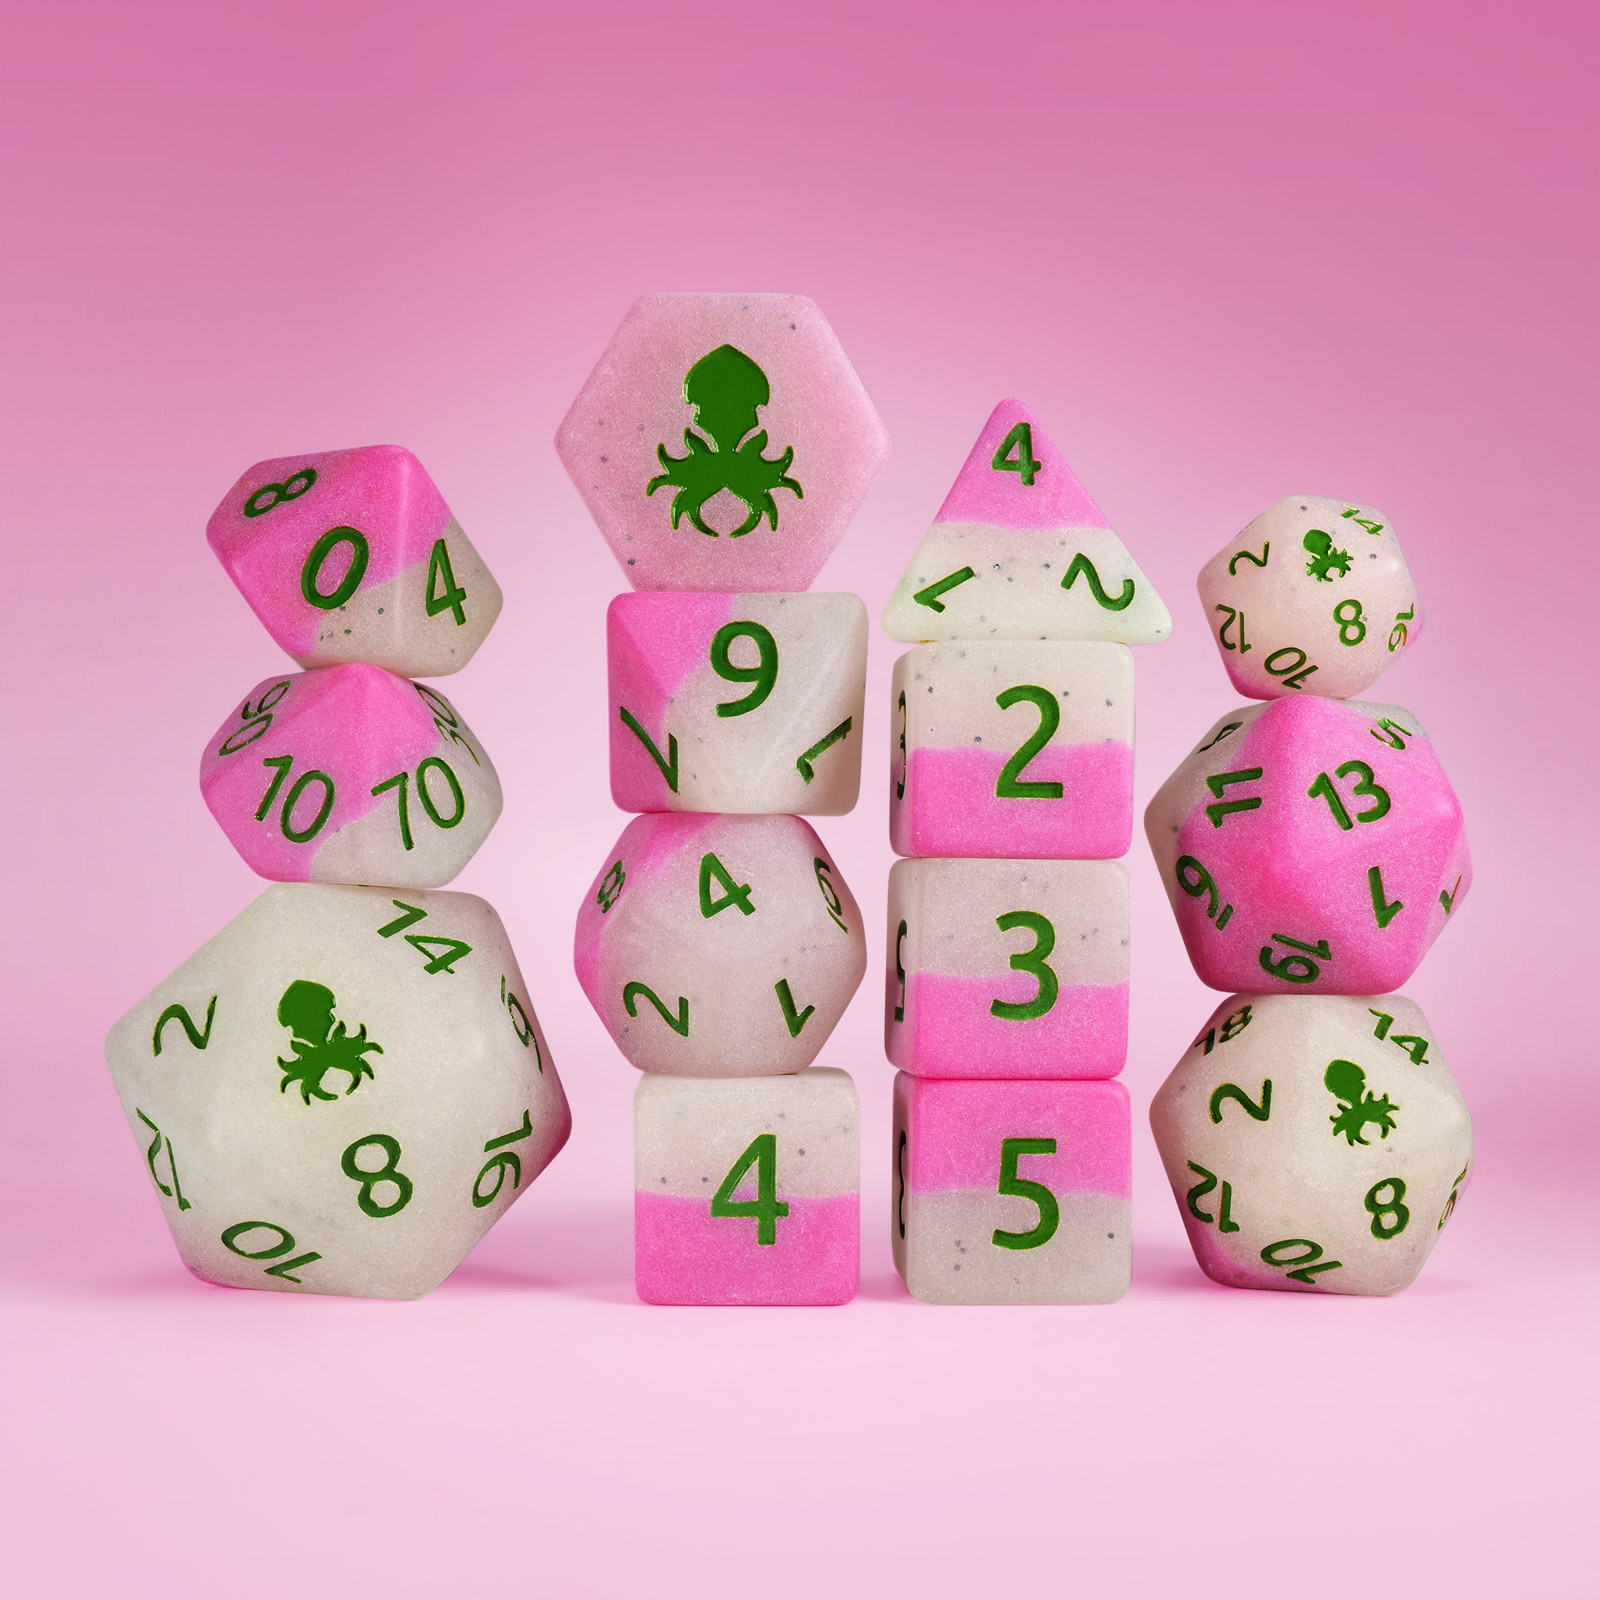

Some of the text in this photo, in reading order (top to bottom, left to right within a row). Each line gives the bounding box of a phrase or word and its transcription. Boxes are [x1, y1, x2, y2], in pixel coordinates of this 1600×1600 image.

[991, 422, 1042, 487] 4
[243, 468, 317, 519] 8
[1341, 504, 1385, 536] 14
[300, 526, 370, 610] 0
[425, 539, 467, 627] 4
[912, 566, 976, 614] 1
[1060, 552, 1137, 613] 2
[1229, 541, 1270, 577] 2
[1217, 604, 1253, 654] 12
[1333, 598, 1367, 647] 8
[995, 684, 1063, 799] 2
[259, 755, 336, 844] 10
[371, 757, 467, 852] 70
[1205, 767, 1263, 829] 11
[1307, 760, 1391, 831] 13
[596, 860, 626, 914] 8
[698, 851, 756, 919] 4
[1367, 865, 1403, 930] 1
[376, 899, 473, 976] 14
[990, 911, 1060, 1022] 3
[152, 993, 218, 1058] 2
[622, 981, 690, 1038] 2
[774, 978, 815, 1039] 1
[1368, 1008, 1430, 1066] 14
[1208, 1078, 1273, 1124] 2
[341, 1133, 414, 1218] 8
[471, 1109, 534, 1209] 16
[710, 1132, 790, 1246] 4
[991, 1137, 1061, 1251] 5
[1186, 1160, 1240, 1234] 12
[1364, 1176, 1411, 1241] 8
[221, 1220, 324, 1285] 10
[1260, 1238, 1343, 1285] 10
